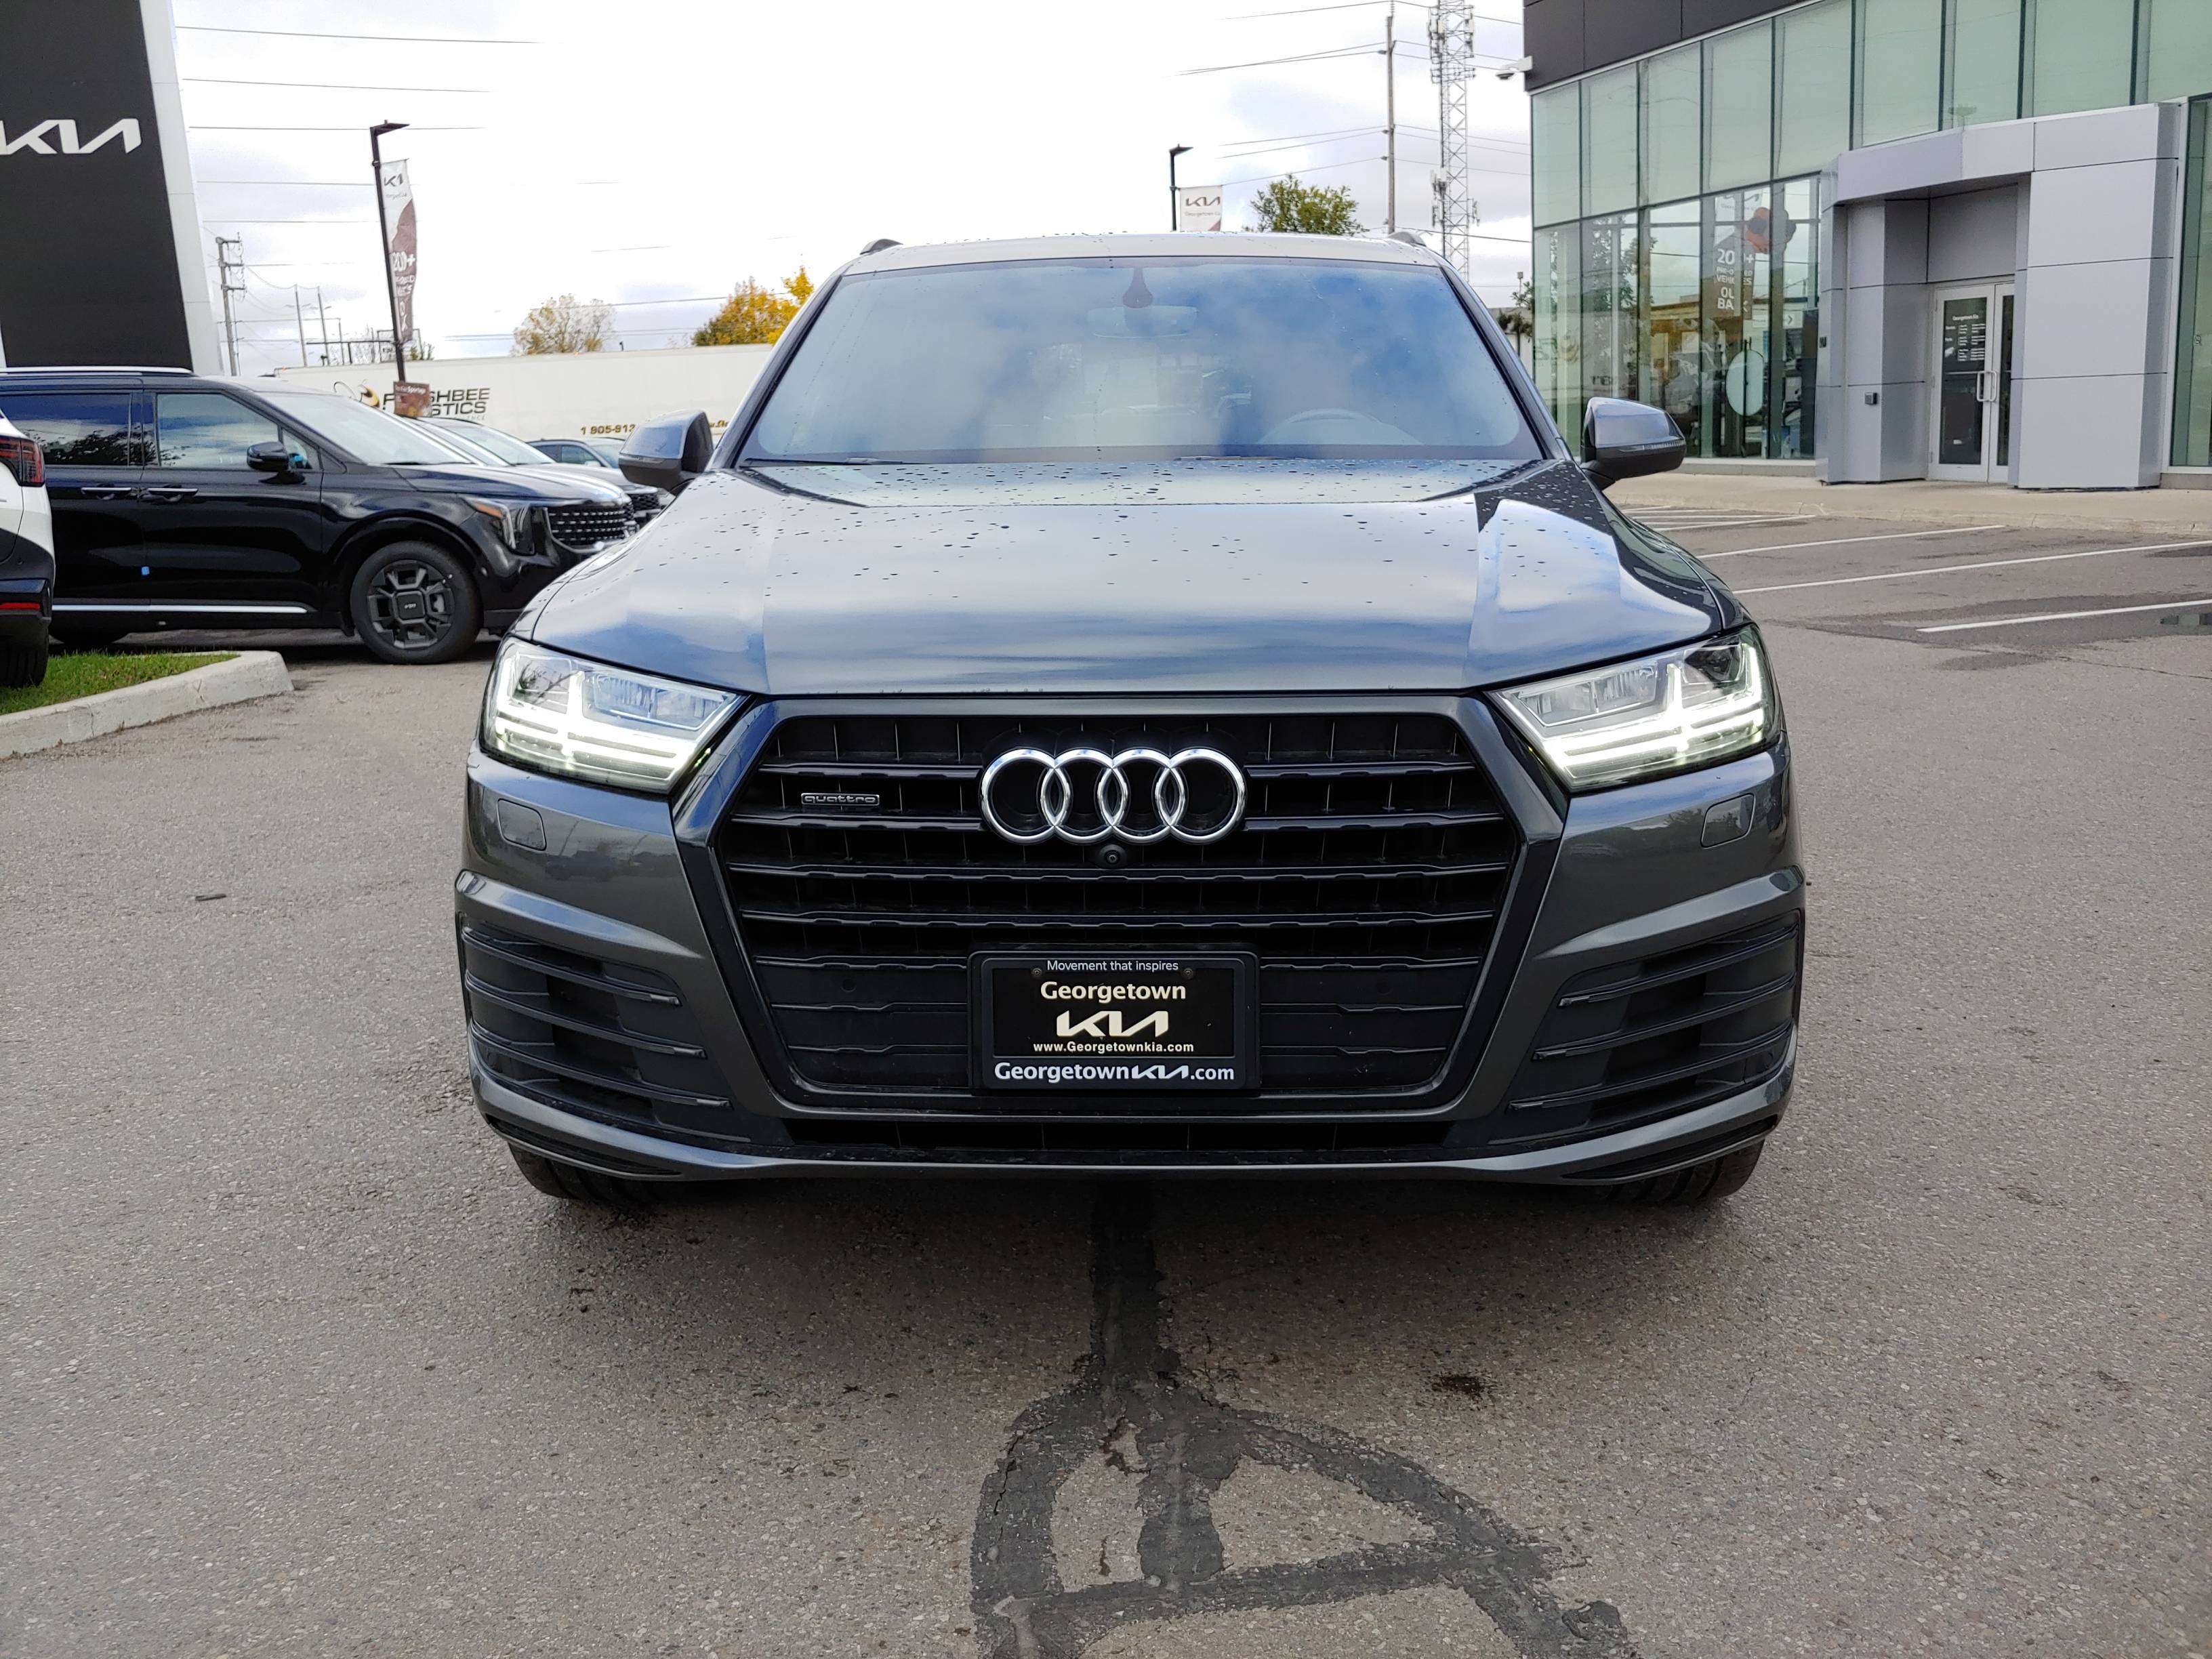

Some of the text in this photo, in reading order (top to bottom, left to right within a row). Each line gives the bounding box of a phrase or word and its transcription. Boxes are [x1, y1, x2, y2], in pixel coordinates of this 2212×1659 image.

[1186, 196, 1221, 207] KIA
[1047, 960, 1179, 972] Movement that inspires
[1040, 981, 1186, 1004] Georgetown
[1056, 1010, 1169, 1038] KIA
[1033, 1042, 1194, 1054] www.Georgetownkia.com
